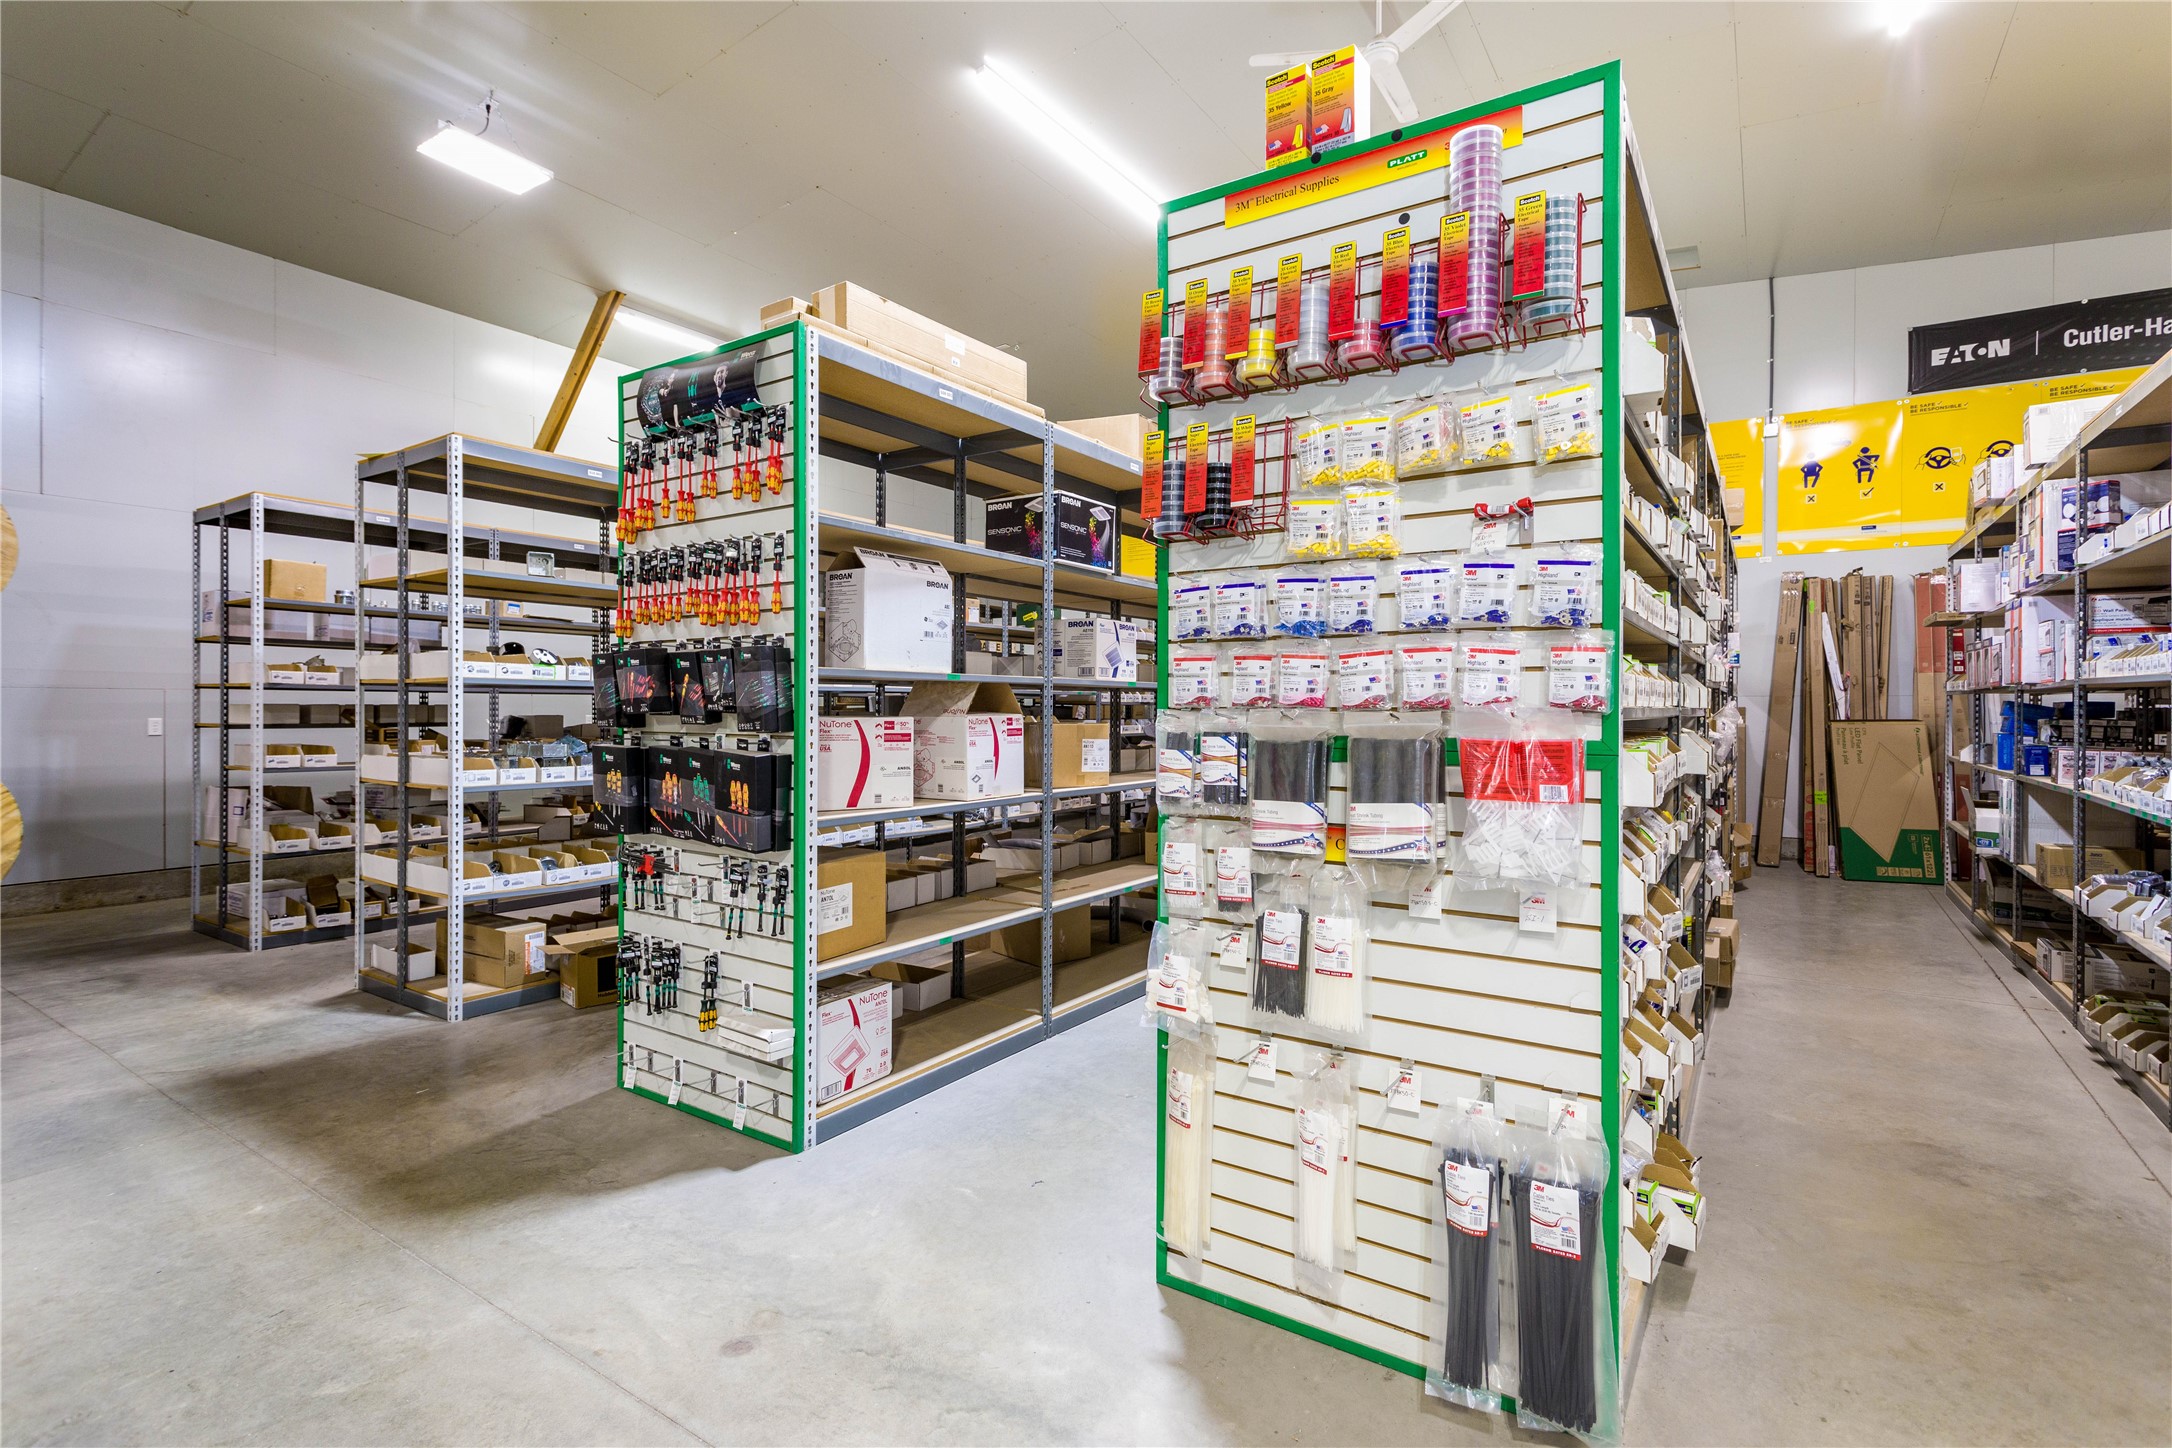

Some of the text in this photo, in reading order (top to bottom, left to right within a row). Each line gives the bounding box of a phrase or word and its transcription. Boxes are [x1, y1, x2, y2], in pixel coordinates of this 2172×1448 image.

[1312, 54, 1336, 69] Scotch
[1265, 73, 1288, 87] Scotch
[1322, 86, 1335, 94] Gray
[1275, 102, 1292, 111] Yellow
[1389, 151, 1426, 168] PLATT
[1255, 186, 1298, 207] Electrical
[1299, 175, 1340, 195] Supplies
[1519, 195, 1540, 206] Scotch
[1518, 209, 1540, 218] Electrical
[1446, 215, 1465, 225] Scotch
[1388, 232, 1405, 240] Scotch
[1444, 228, 1464, 236] Electrical
[1335, 244, 1352, 253] Scotch
[1282, 257, 1298, 265] Scotch
[1190, 282, 1204, 290] Scotch
[1146, 292, 1160, 300] Scotch
[1931, 338, 2010, 367] EATON
[2060, 386, 2107, 396] RESPONSIBLE
[1919, 403, 1962, 413] RESPONSIBLE
[1190, 425, 1205, 433] Scotch
[1061, 495, 1082, 507] BROAN
[988, 502, 1013, 512] BROAN
[988, 526, 1022, 535] SENSONIC
[1060, 521, 1087, 534] SENSONIC
[1484, 522, 1496, 530] 3M
[829, 572, 853, 581] BROAN
[926, 580, 949, 590] BROAN
[1068, 620, 1094, 628] BROAN
[1119, 623, 1135, 632] BROAN
[819, 720, 852, 728] NuTone
[860, 990, 888, 1006] NuTone
[1258, 1048, 1269, 1056] 3M
[1400, 1076, 1412, 1085] 3M
[1447, 1163, 1458, 1173] 3M
[1533, 1184, 1545, 1193] 3M
[1532, 1192, 1555, 1202] Cable Ties
